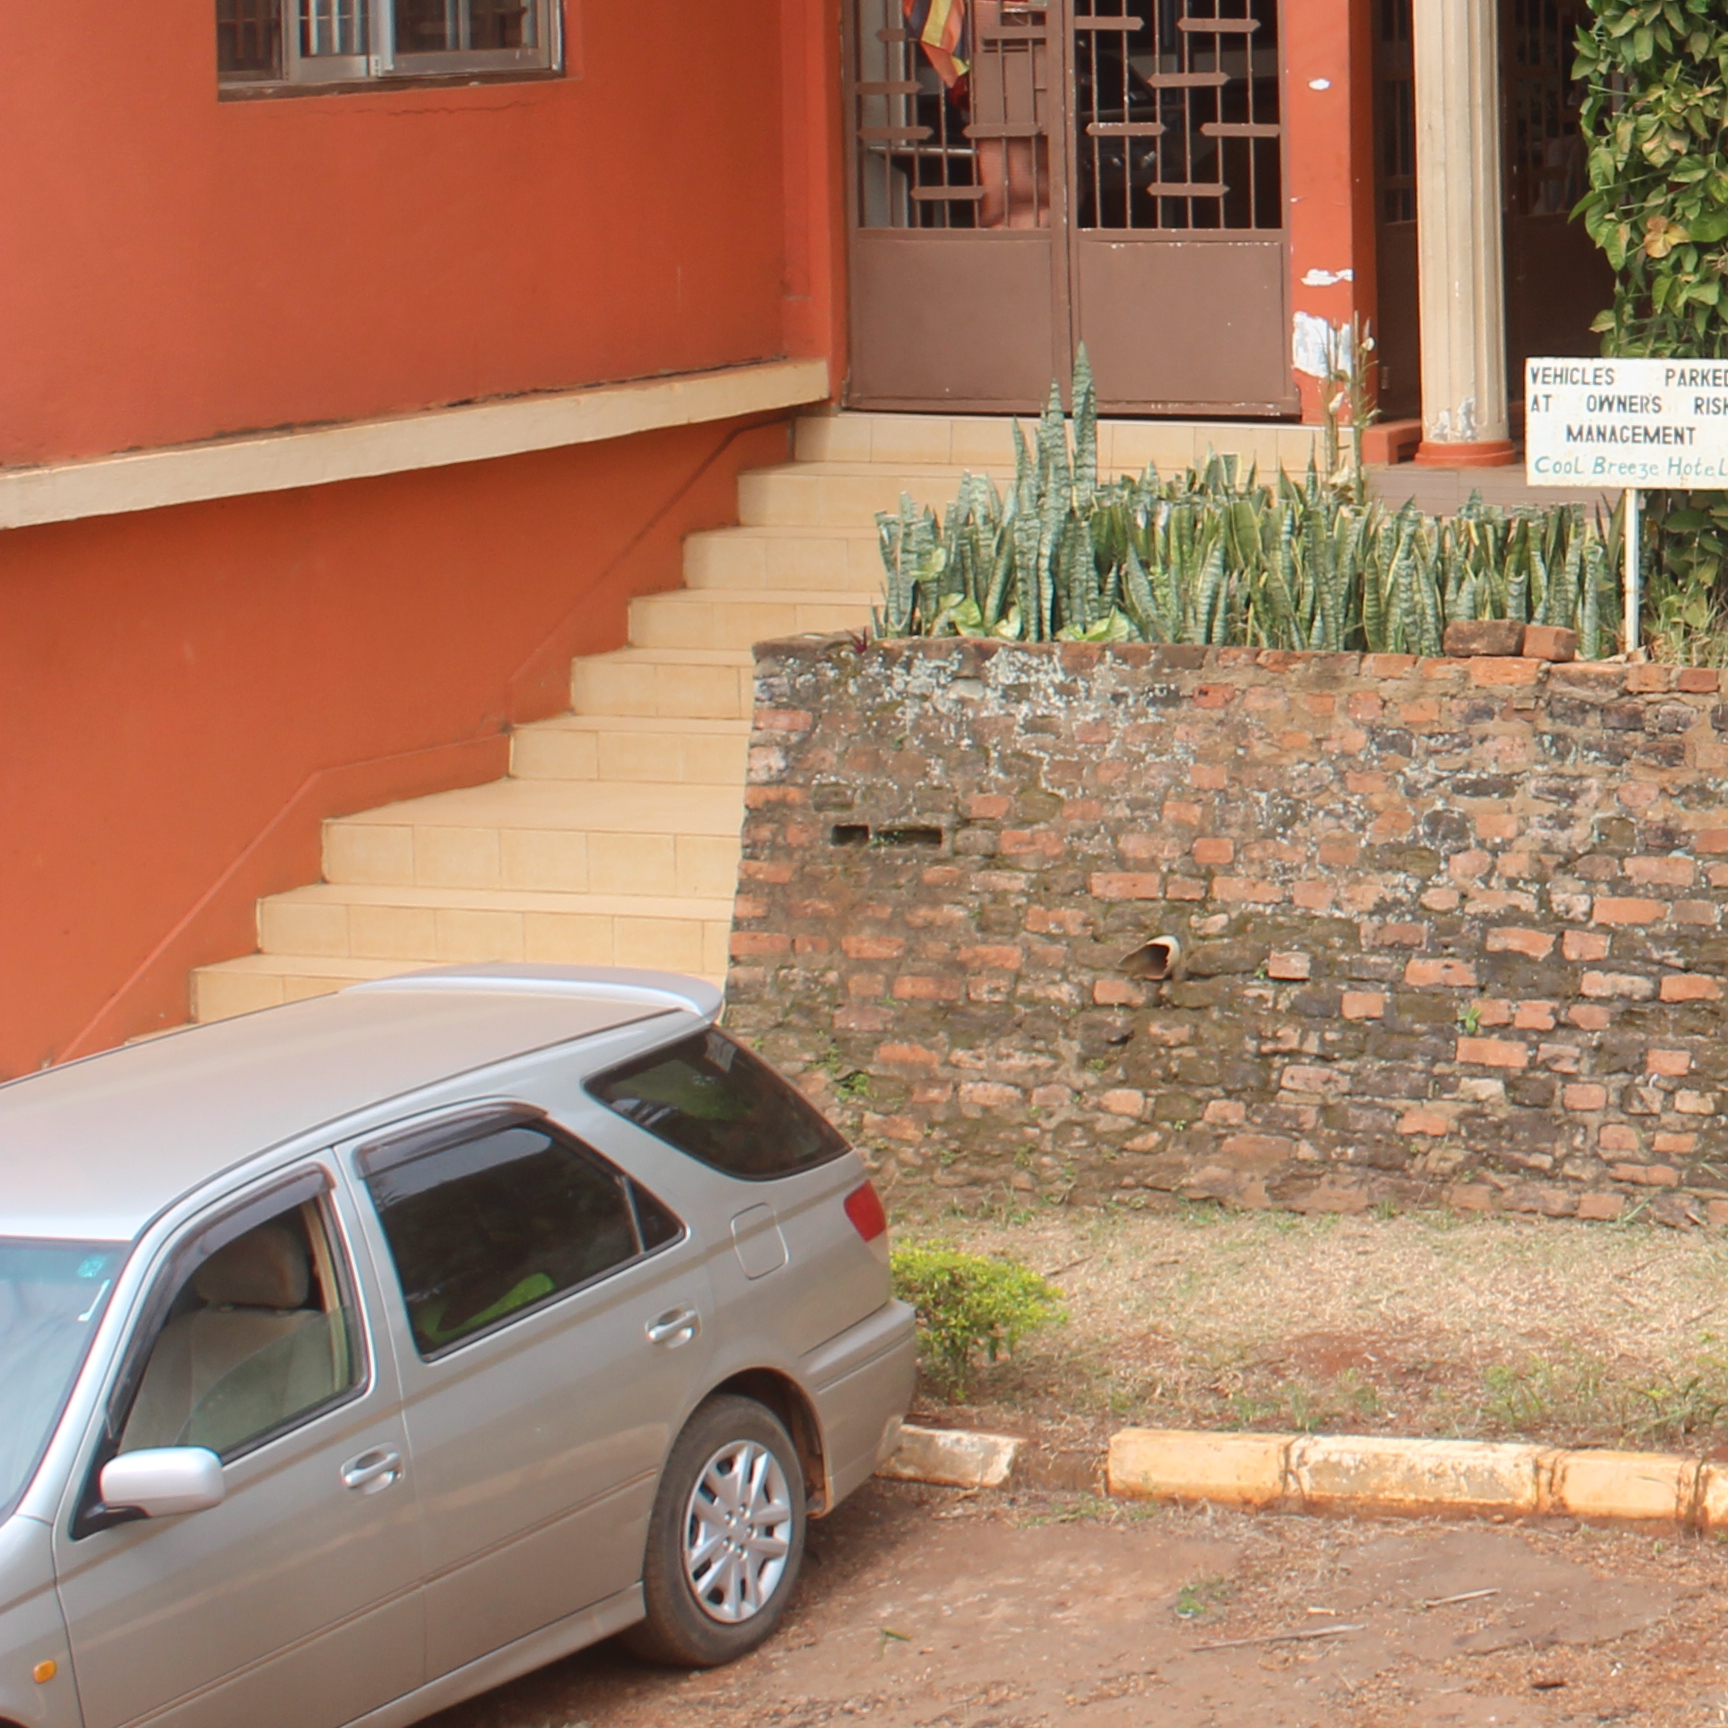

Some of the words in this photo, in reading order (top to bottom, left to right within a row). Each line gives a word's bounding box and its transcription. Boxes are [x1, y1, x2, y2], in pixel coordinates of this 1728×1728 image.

[1530, 394, 1553, 413] AT
[1565, 424, 1697, 445] MANAGEMENT
[1592, 456, 1660, 480] Breeze
[1667, 456, 1728, 477] Hotel
